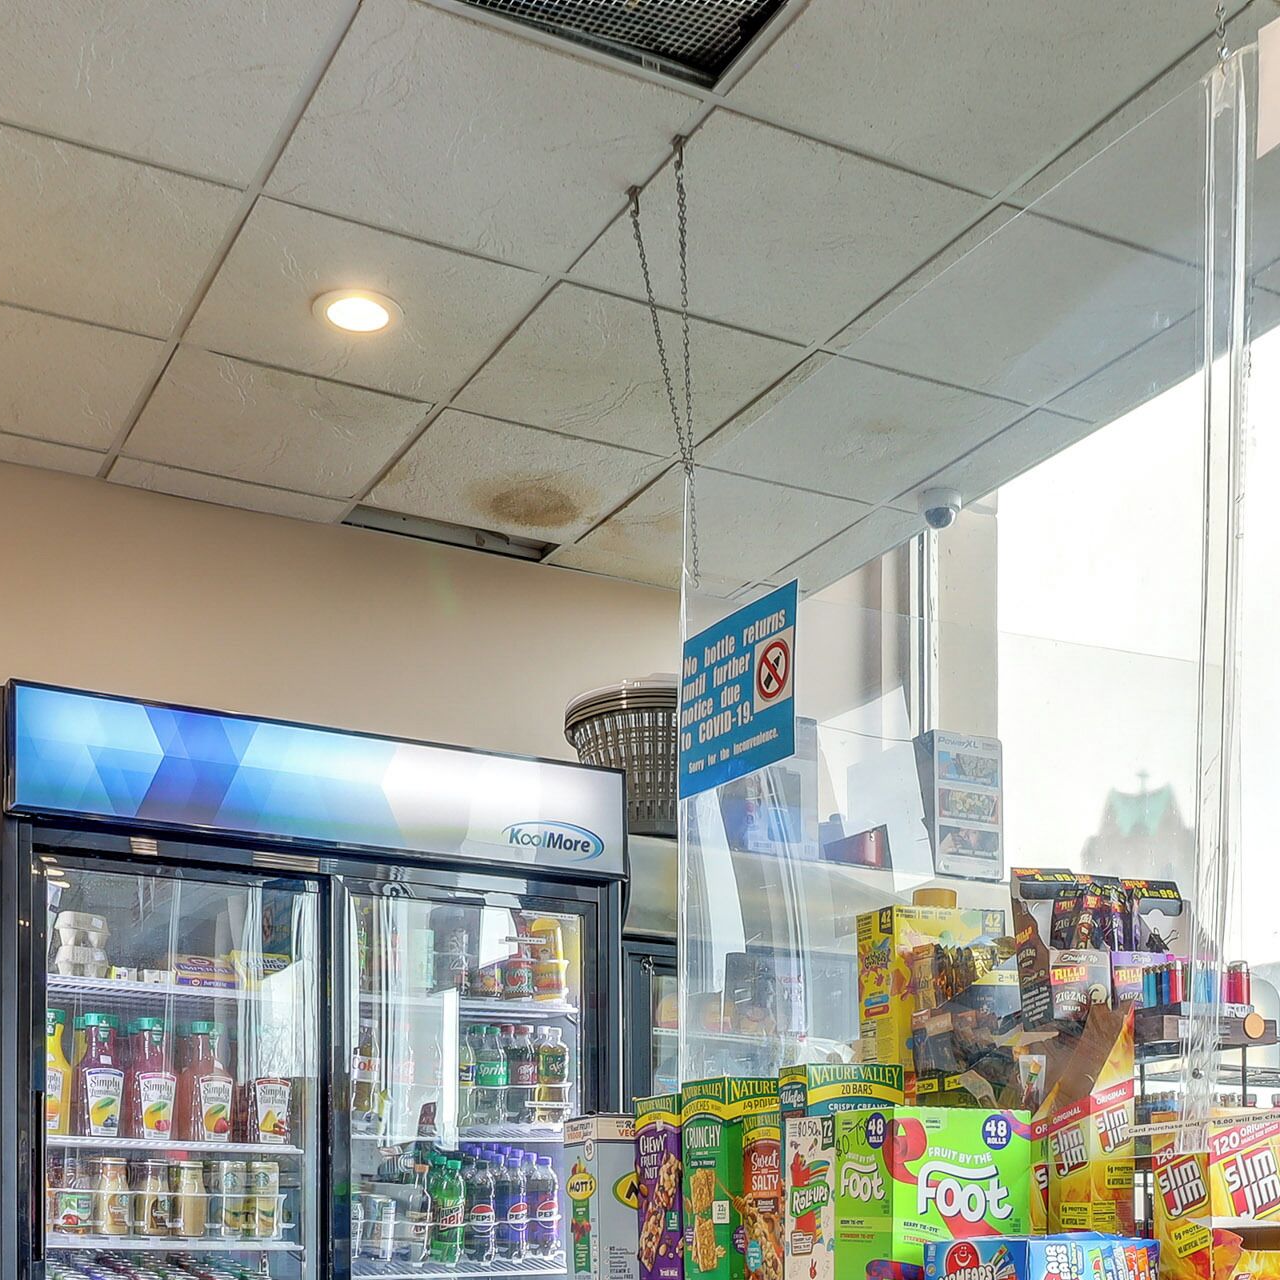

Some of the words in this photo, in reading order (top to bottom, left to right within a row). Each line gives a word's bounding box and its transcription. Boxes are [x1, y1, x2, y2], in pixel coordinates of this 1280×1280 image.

[683, 656, 698, 679] No
[704, 635, 736, 668] bottle
[742, 608, 786, 648] returns
[682, 675, 706, 702] until
[713, 650, 751, 689] further
[681, 699, 714, 728] notice
[721, 684, 741, 708] due
[680, 731, 692, 752] to
[698, 701, 754, 745] COVID-19.
[937, 735, 979, 750] PowerXL
[688, 757, 705, 776] Sorry
[509, 827, 591, 856] KoolMore
[90, 1076, 121, 1091] Simply
[810, 1066, 861, 1082] NATURE
[858, 1066, 900, 1084] VALLEY
[259, 1085, 287, 1099] Simply
[841, 1084, 850, 1095] 20
[852, 1085, 873, 1095] BARS
[1096, 1087, 1126, 1106] ORIGINAL
[985, 1118, 1008, 1136] 48
[640, 1134, 667, 1154] CHEWY
[685, 1125, 721, 1148] CRUNCHY
[987, 1136, 1006, 1145] ROLLS
[1212, 1134, 1239, 1157] 120
[640, 1153, 657, 1167] FRUIT
[751, 1152, 779, 1170] Sweet
[928, 1146, 956, 1162] FRUIT
[957, 1150, 970, 1163] BY
[972, 1150, 992, 1163] THE
[644, 1166, 659, 1179] NUT
[569, 1180, 593, 1191] MOTT'S
[751, 1174, 779, 1191] SALTY
